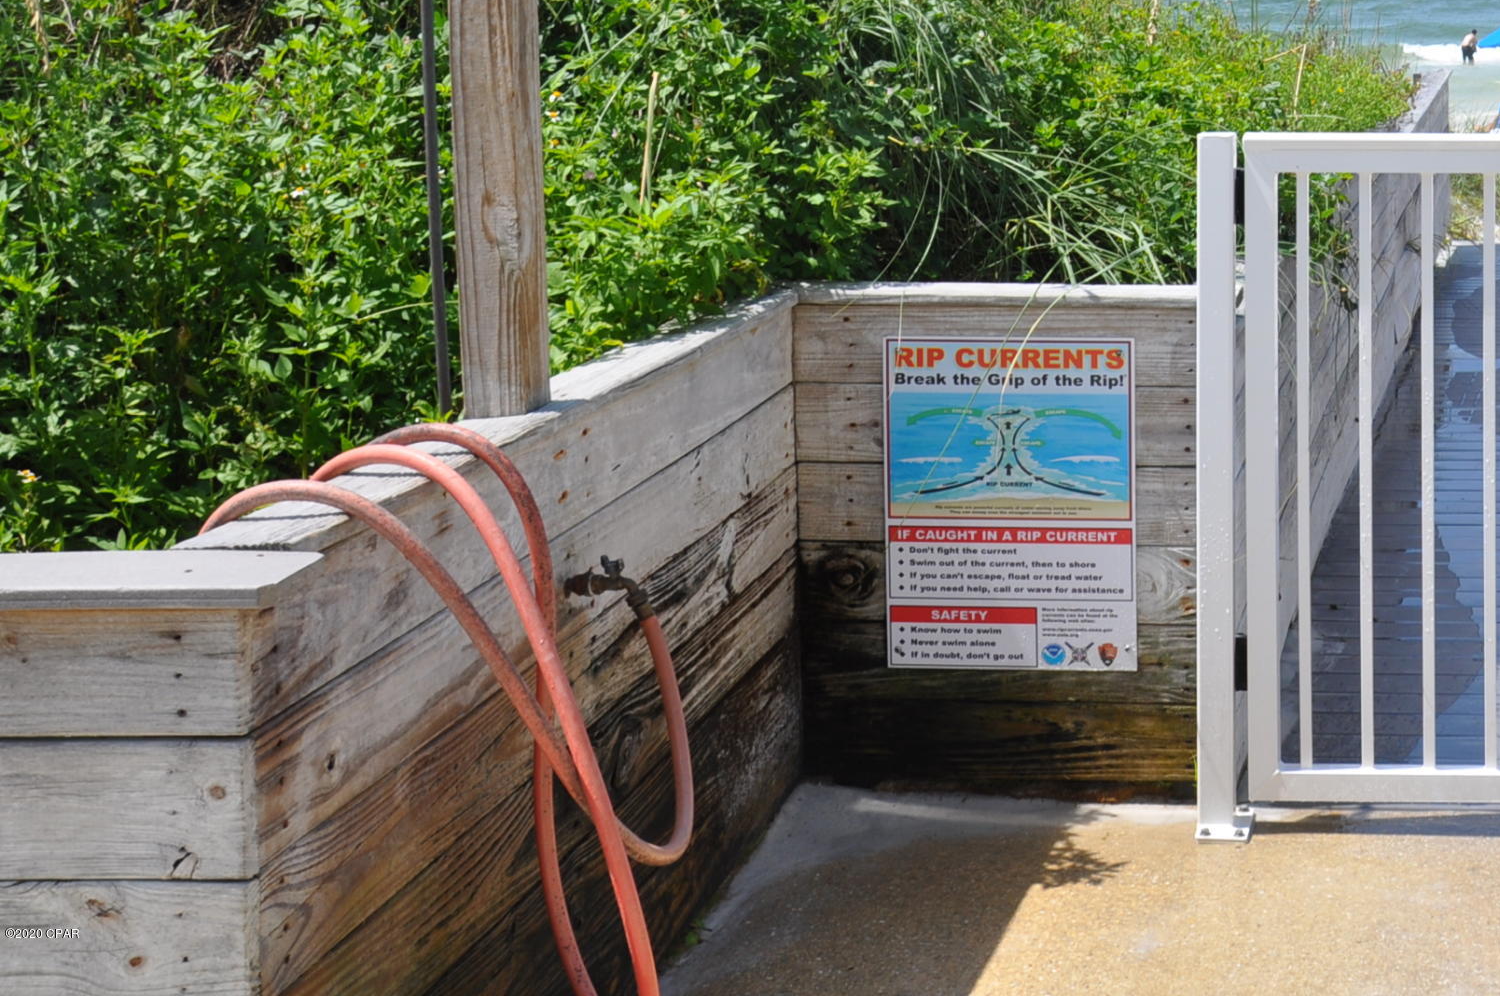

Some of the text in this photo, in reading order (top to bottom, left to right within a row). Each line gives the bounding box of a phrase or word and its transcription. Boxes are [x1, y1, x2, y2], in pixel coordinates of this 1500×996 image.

[895, 348, 1124, 369] RIP CURRENTS
[894, 373, 1124, 389] Break the Grip of the Rip!
[897, 530, 1117, 542] IF CAUGHT IN A RIP CURRENT
[937, 547, 959, 556] fight
[981, 547, 1017, 555] current
[989, 560, 1028, 568] current,
[1031, 560, 1053, 568] then
[940, 572, 964, 580] can't
[967, 574, 1005, 582] escape,
[1046, 573, 1072, 581] tread
[920, 586, 937, 594] you
[966, 585, 990, 594] help,
[931, 610, 988, 620] SAFETY
[910, 626, 938, 634] Know
[970, 639, 996, 647] alone
[933, 652, 964, 660] doubt,
[1008, 652, 1024, 660] out
